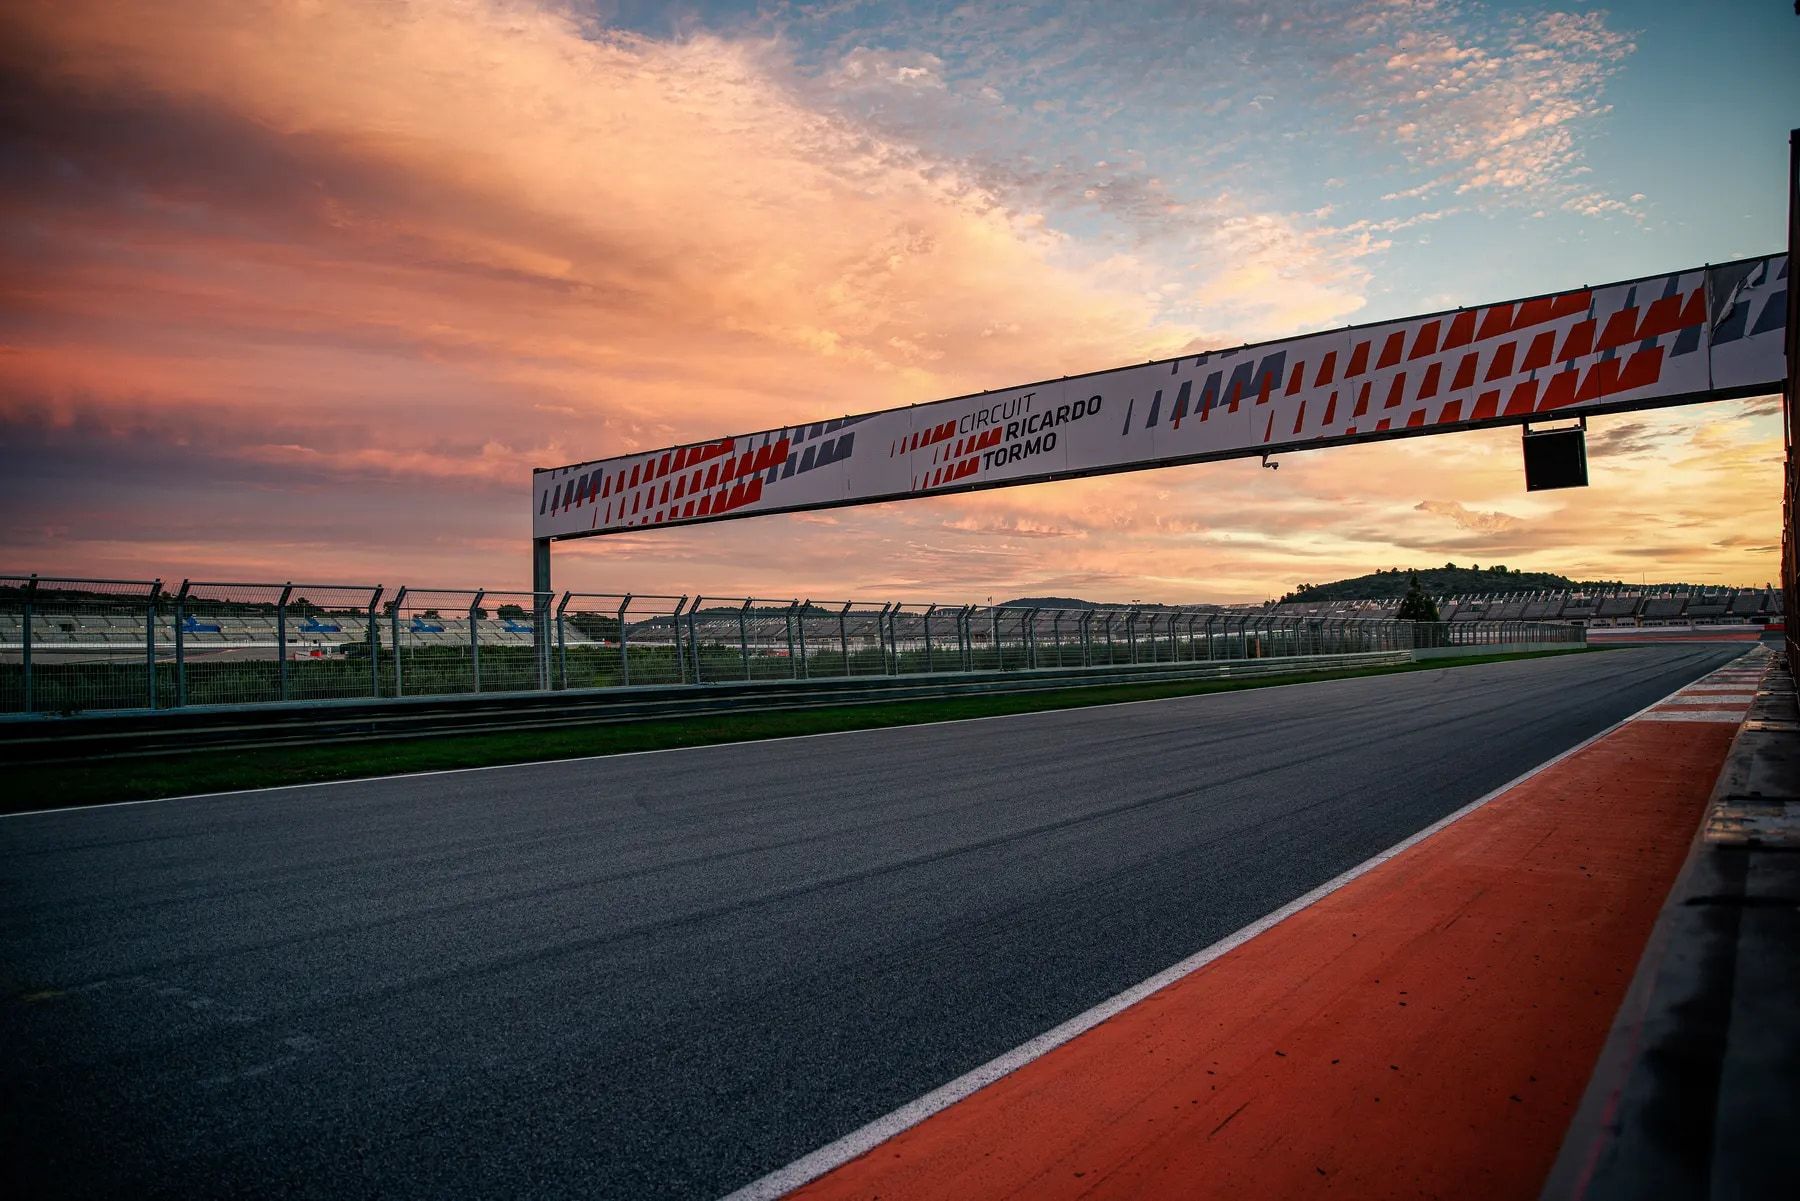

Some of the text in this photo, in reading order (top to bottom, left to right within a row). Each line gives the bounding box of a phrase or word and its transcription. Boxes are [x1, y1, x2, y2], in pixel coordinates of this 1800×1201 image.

[960, 393, 1036, 434] CIRCUIT
[1005, 395, 1102, 442] RICARDO
[983, 432, 1057, 470] TORMO
